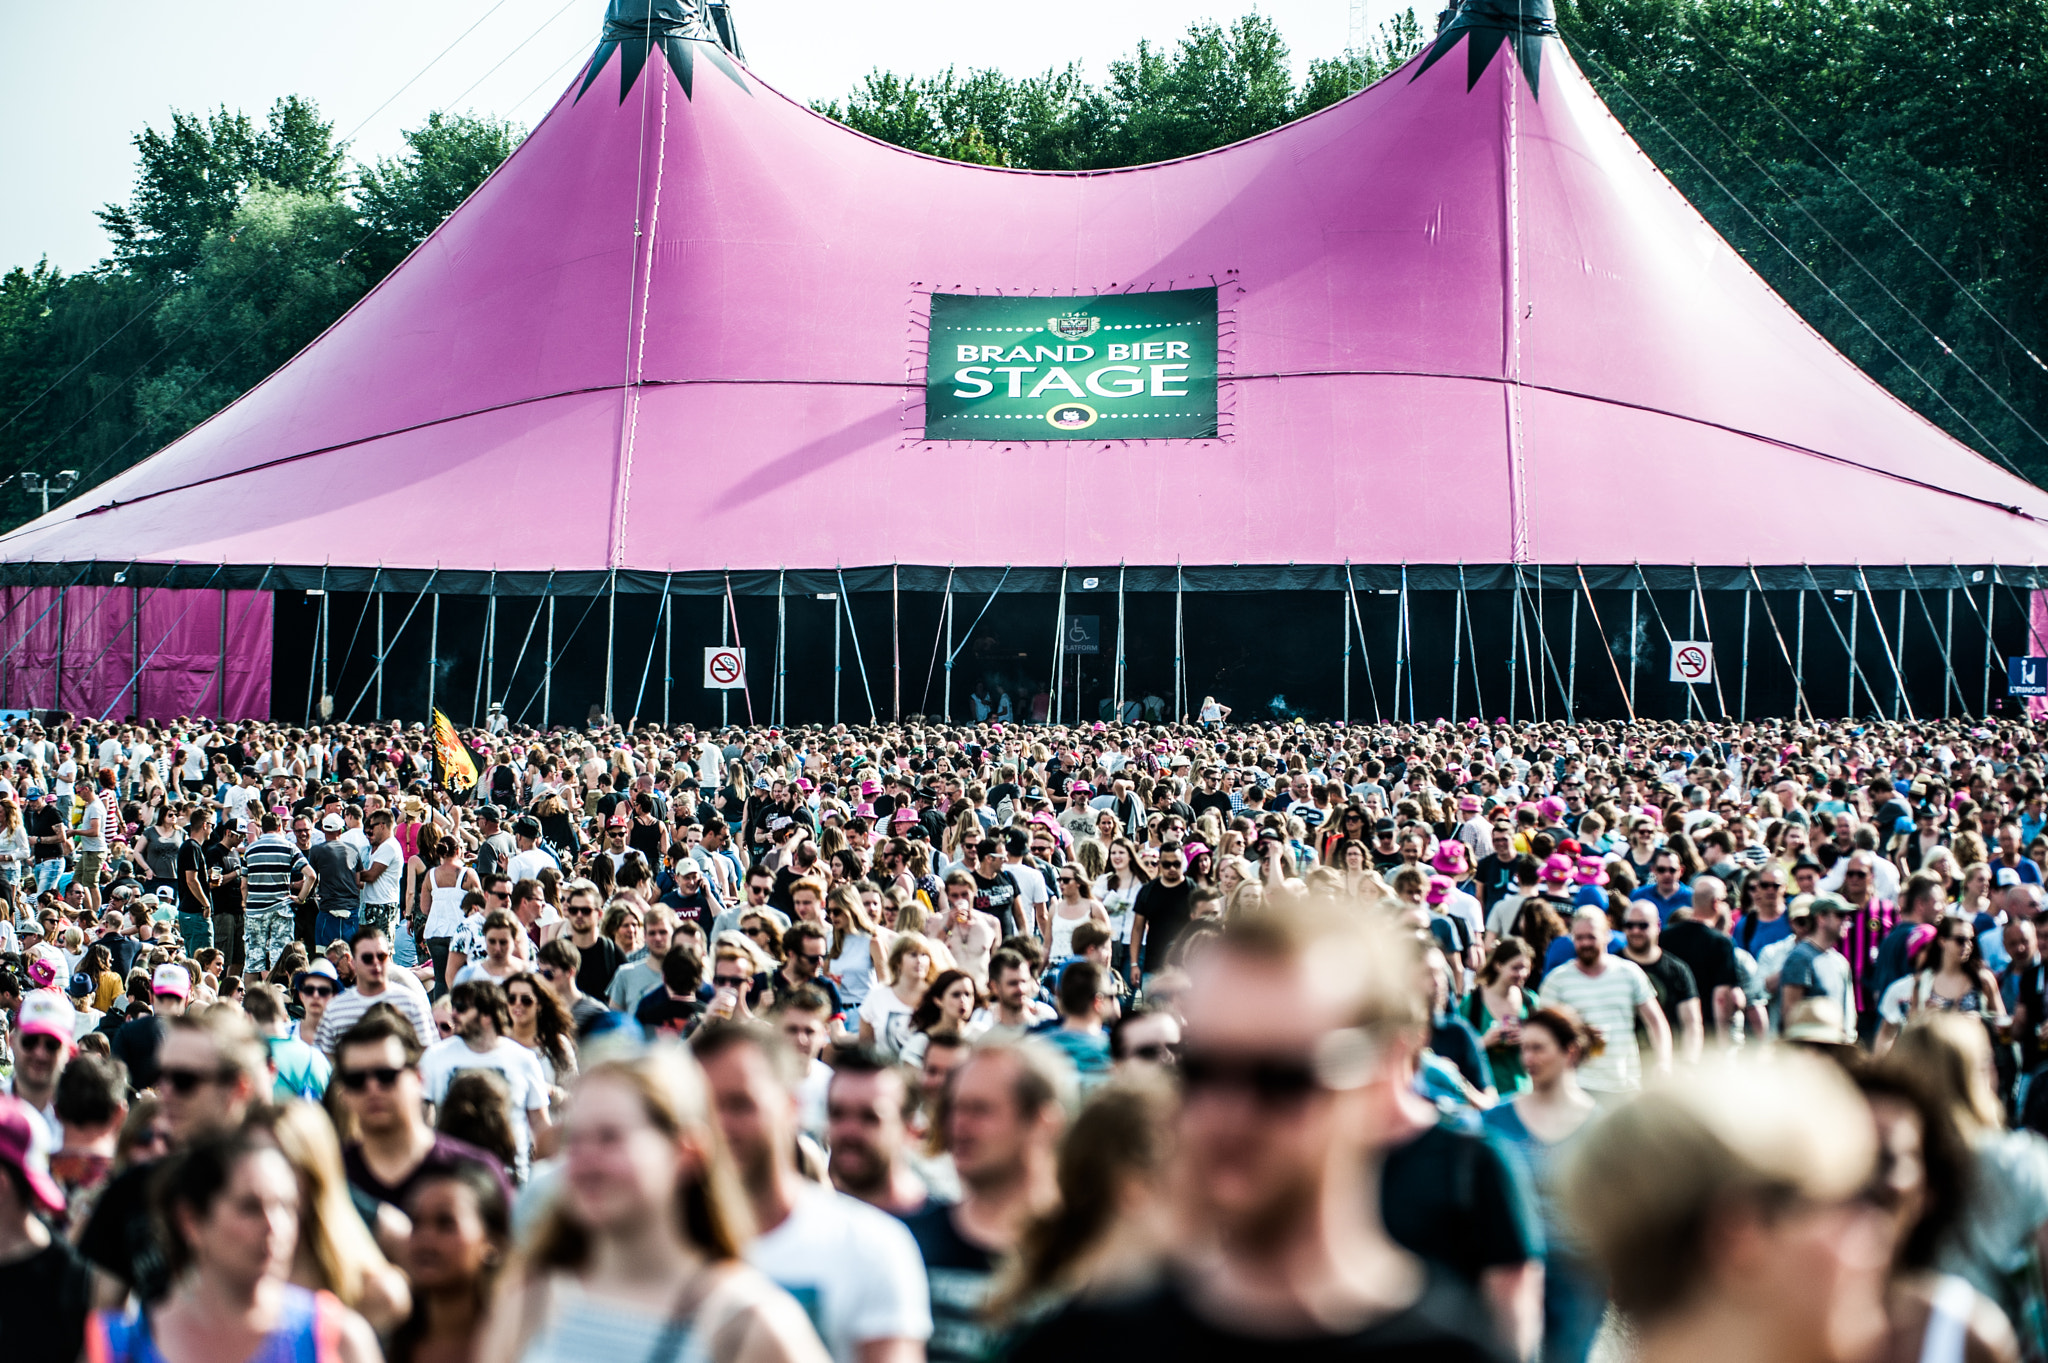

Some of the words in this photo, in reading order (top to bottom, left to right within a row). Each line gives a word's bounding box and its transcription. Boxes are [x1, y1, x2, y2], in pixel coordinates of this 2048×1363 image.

[957, 345, 1095, 362] BRAND
[1108, 341, 1191, 360] BIER
[953, 364, 1189, 399] STAGE
